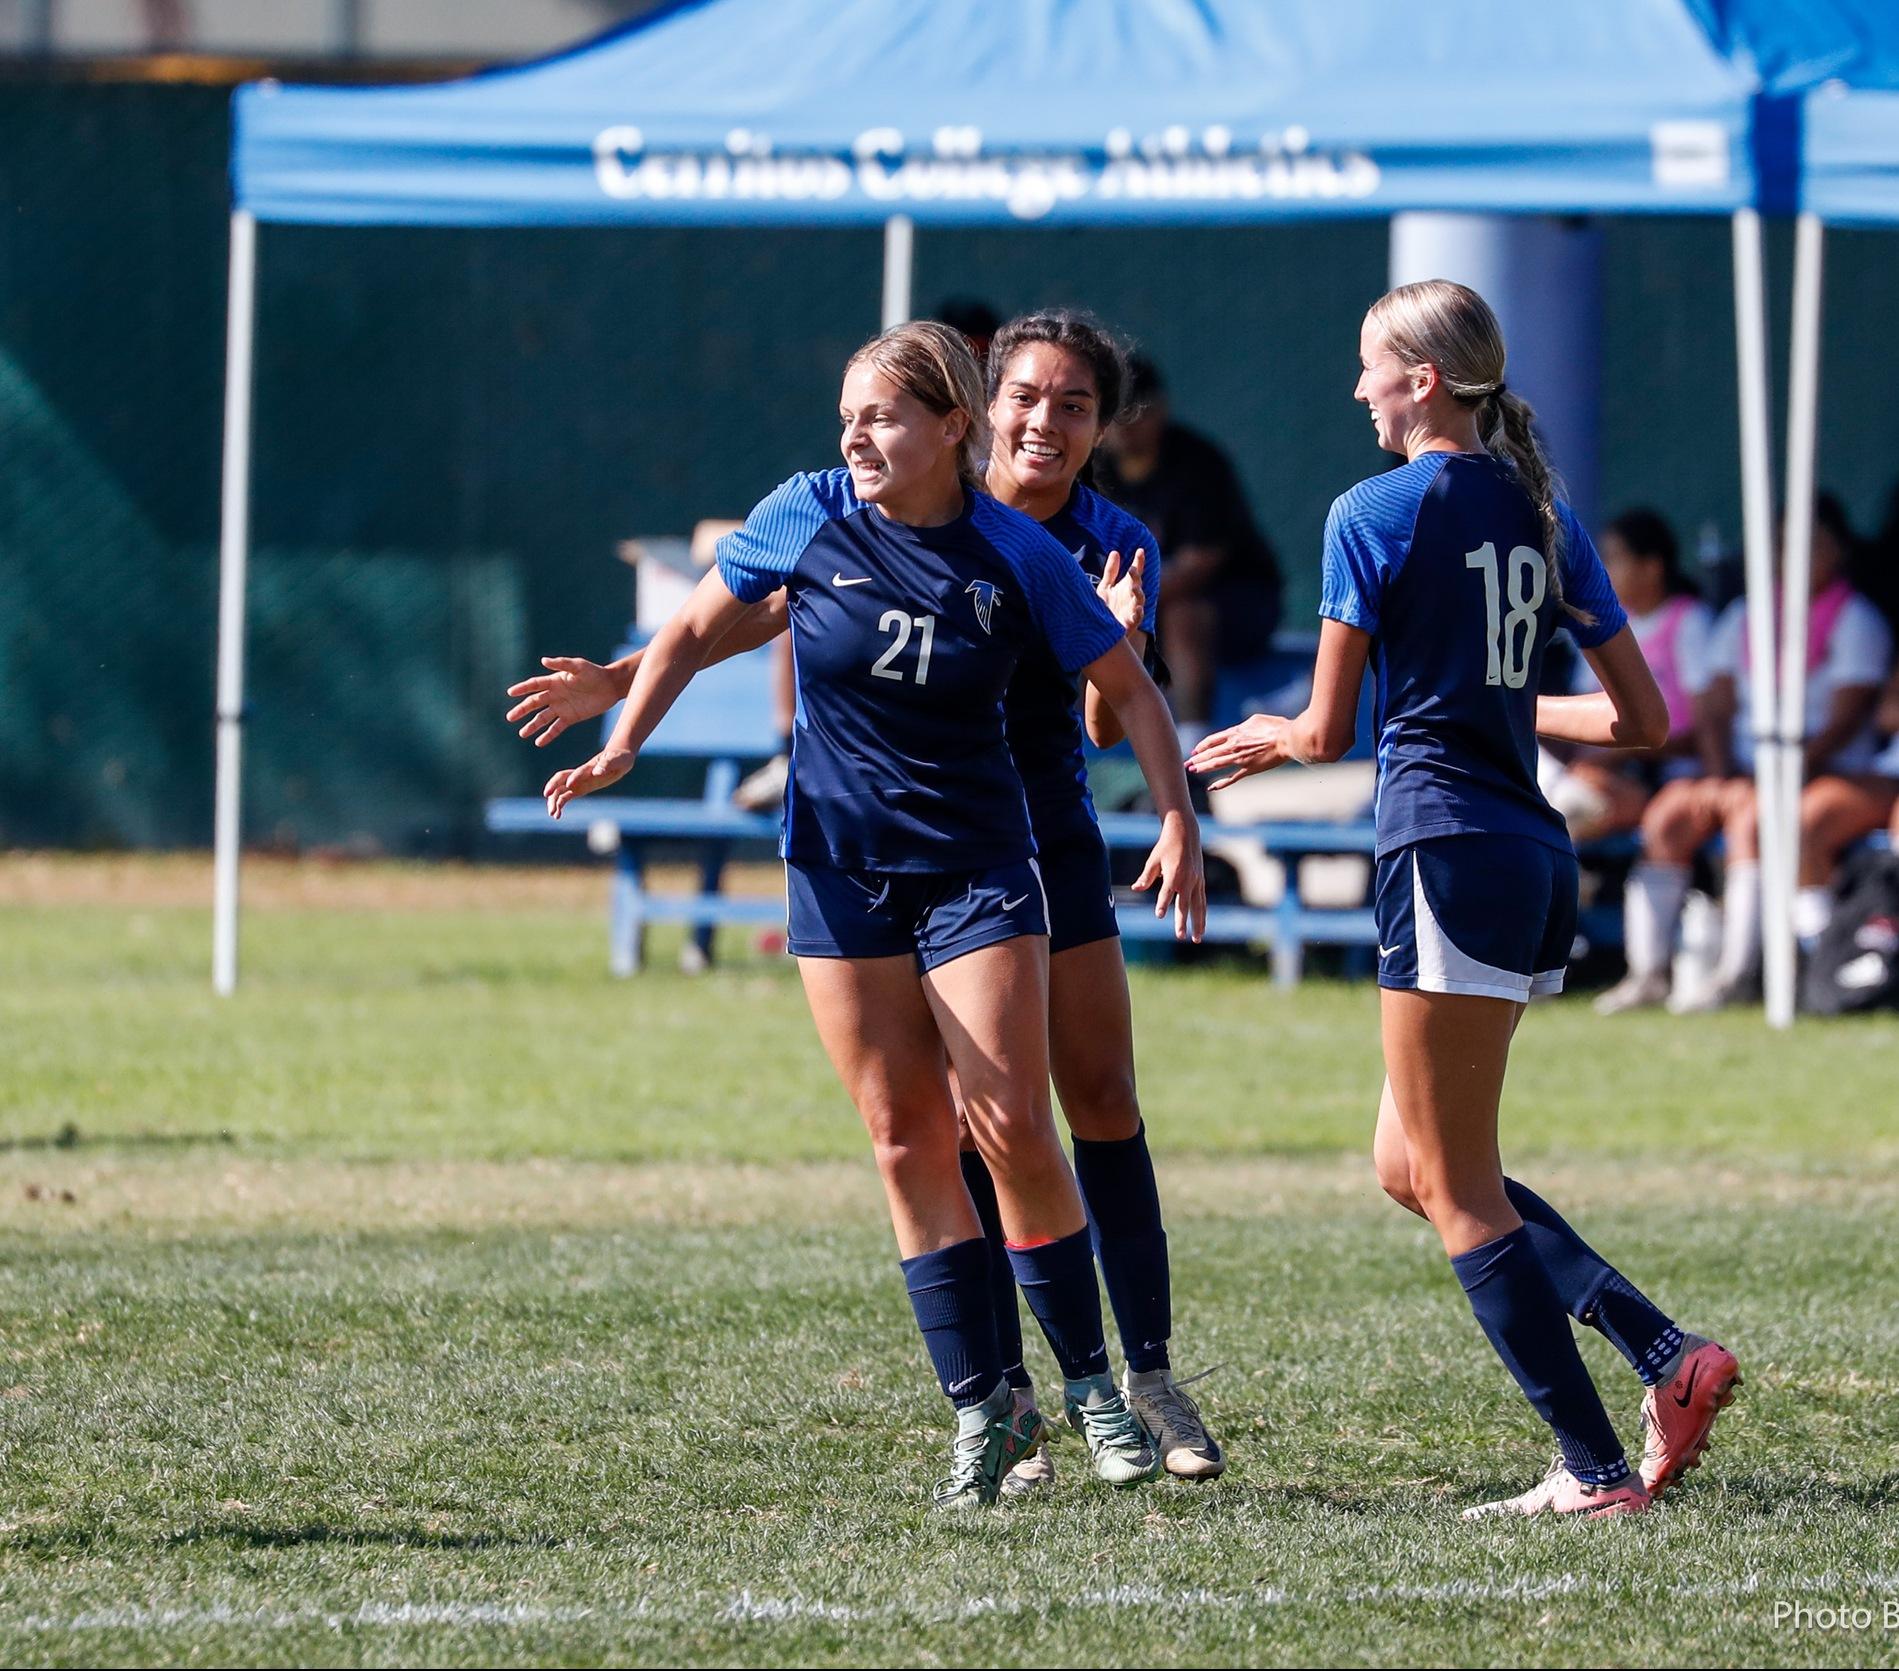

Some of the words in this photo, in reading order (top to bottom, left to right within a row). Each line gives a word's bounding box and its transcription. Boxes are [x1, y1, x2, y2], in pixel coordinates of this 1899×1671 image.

[854, 125, 1090, 220] College
[870, 609, 935, 686] 21
[1465, 541, 1547, 689] 18
